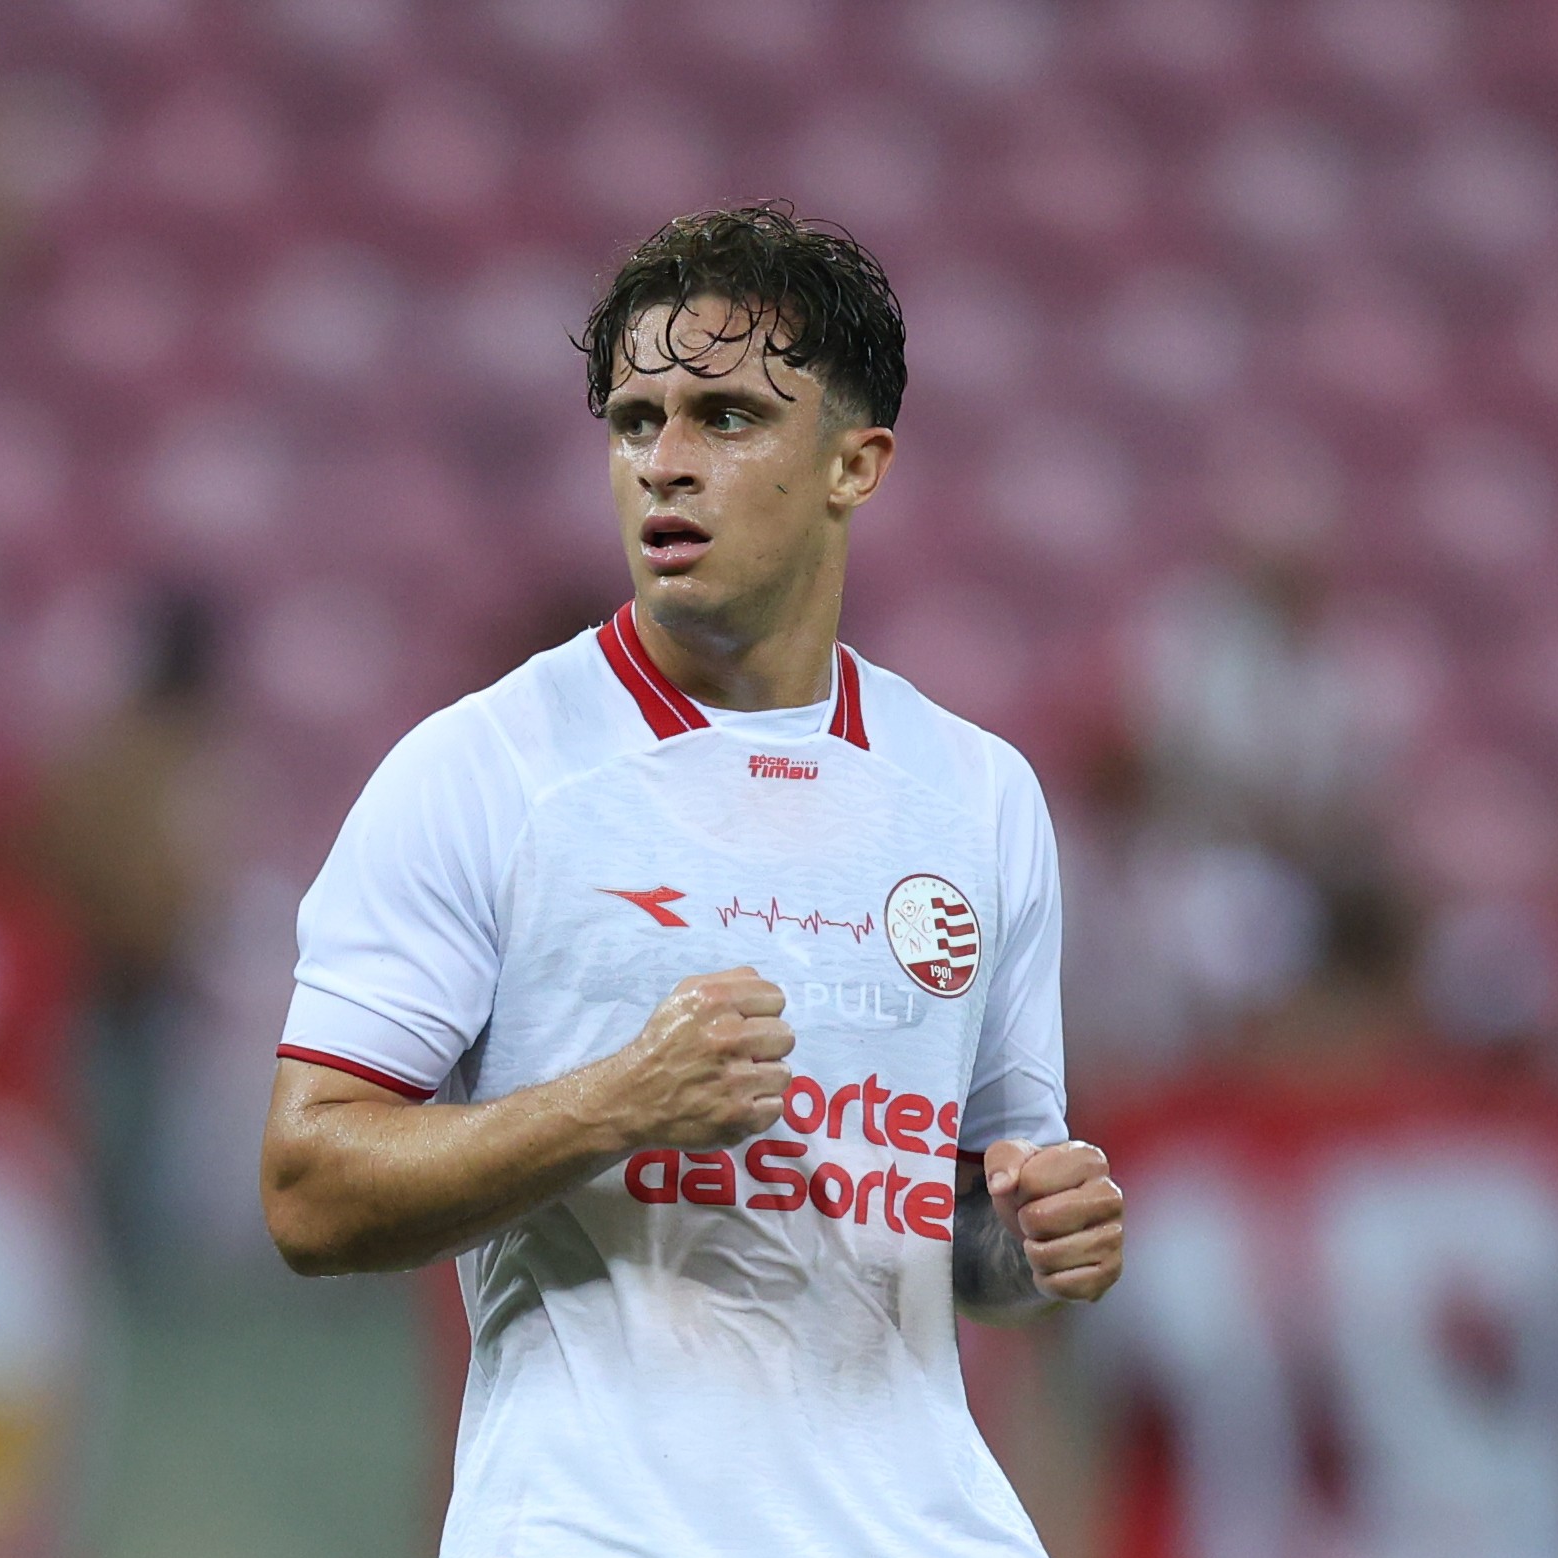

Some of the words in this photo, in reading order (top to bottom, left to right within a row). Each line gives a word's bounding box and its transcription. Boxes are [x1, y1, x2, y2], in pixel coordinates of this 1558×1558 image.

[748, 764, 819, 780] TIMBU
[929, 964, 953, 980] 1901
[745, 1138, 956, 1242] Sorte
